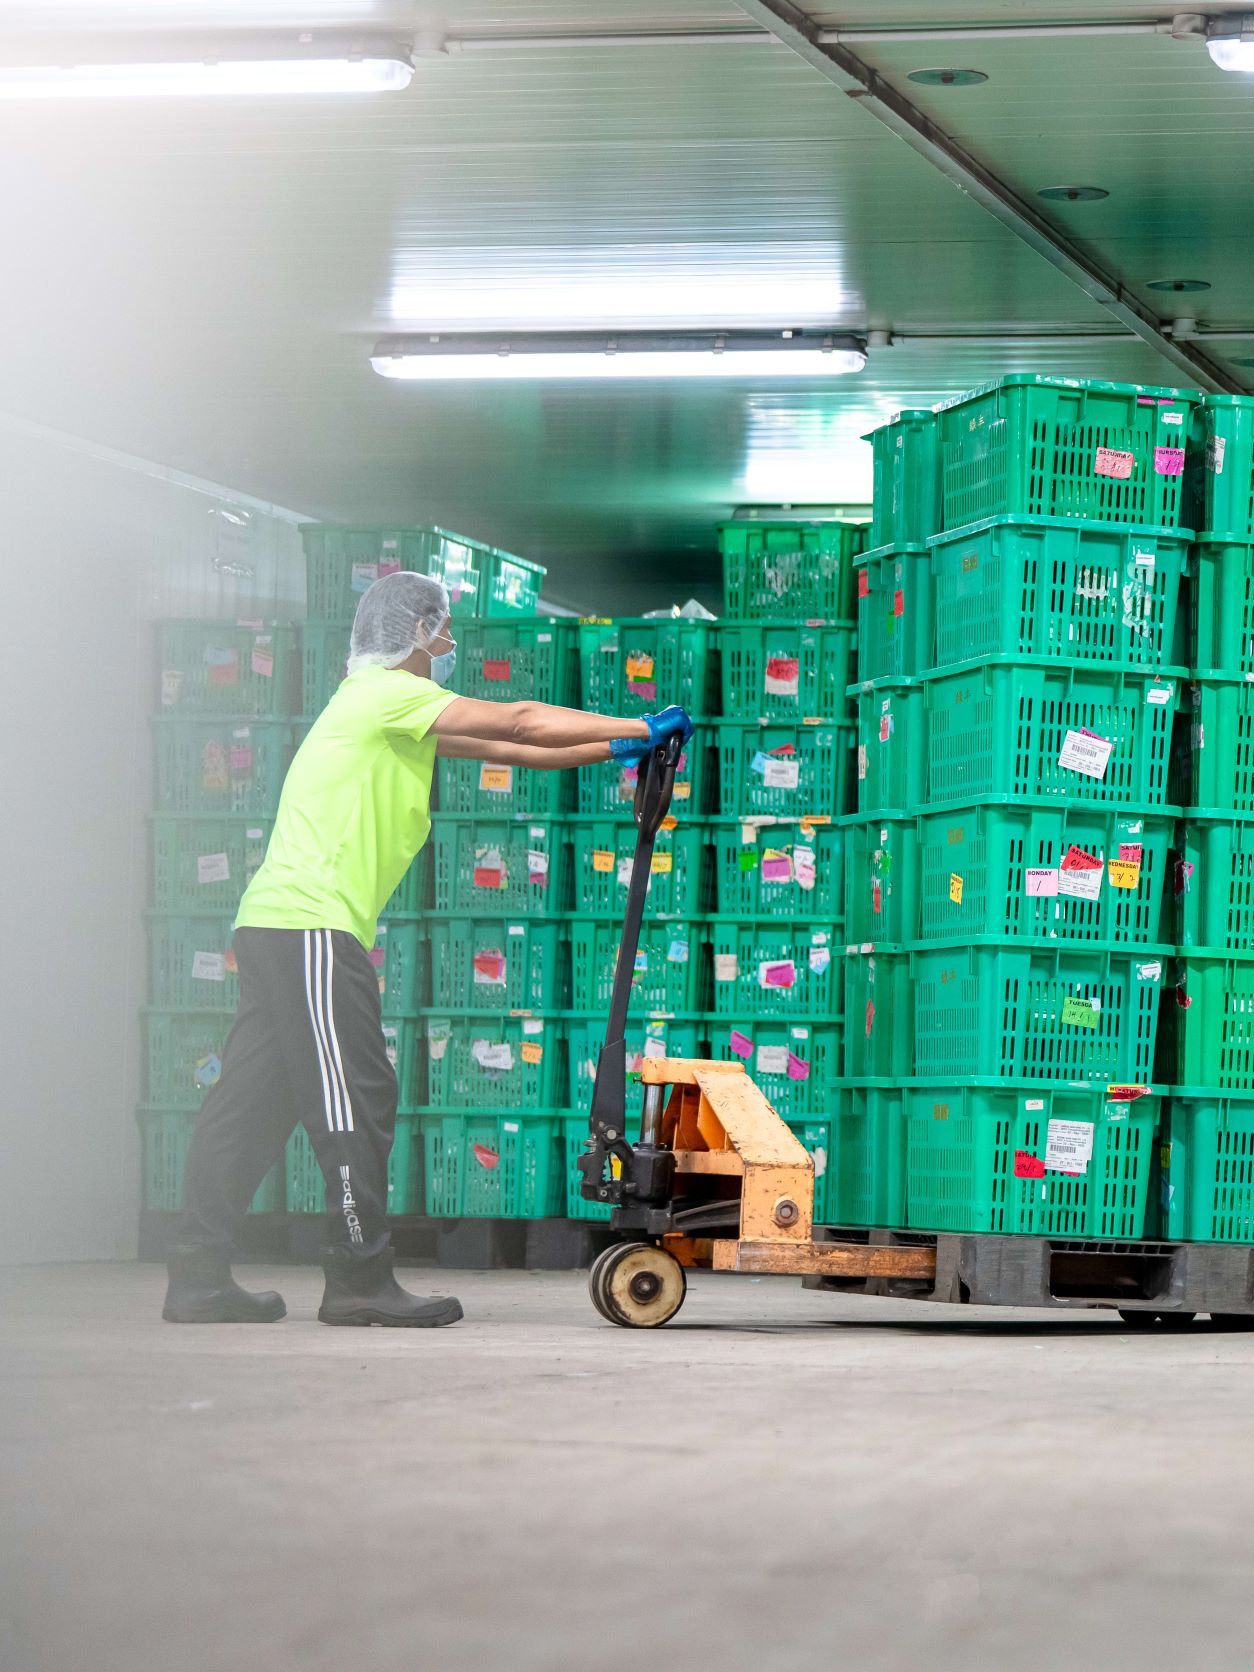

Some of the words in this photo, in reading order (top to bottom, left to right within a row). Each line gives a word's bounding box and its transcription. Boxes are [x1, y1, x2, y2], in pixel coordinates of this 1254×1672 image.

[1071, 847, 1100, 867] SATURDAY
[1069, 1000, 1093, 1008] TUESDA
[342, 1180, 362, 1236] adidas
